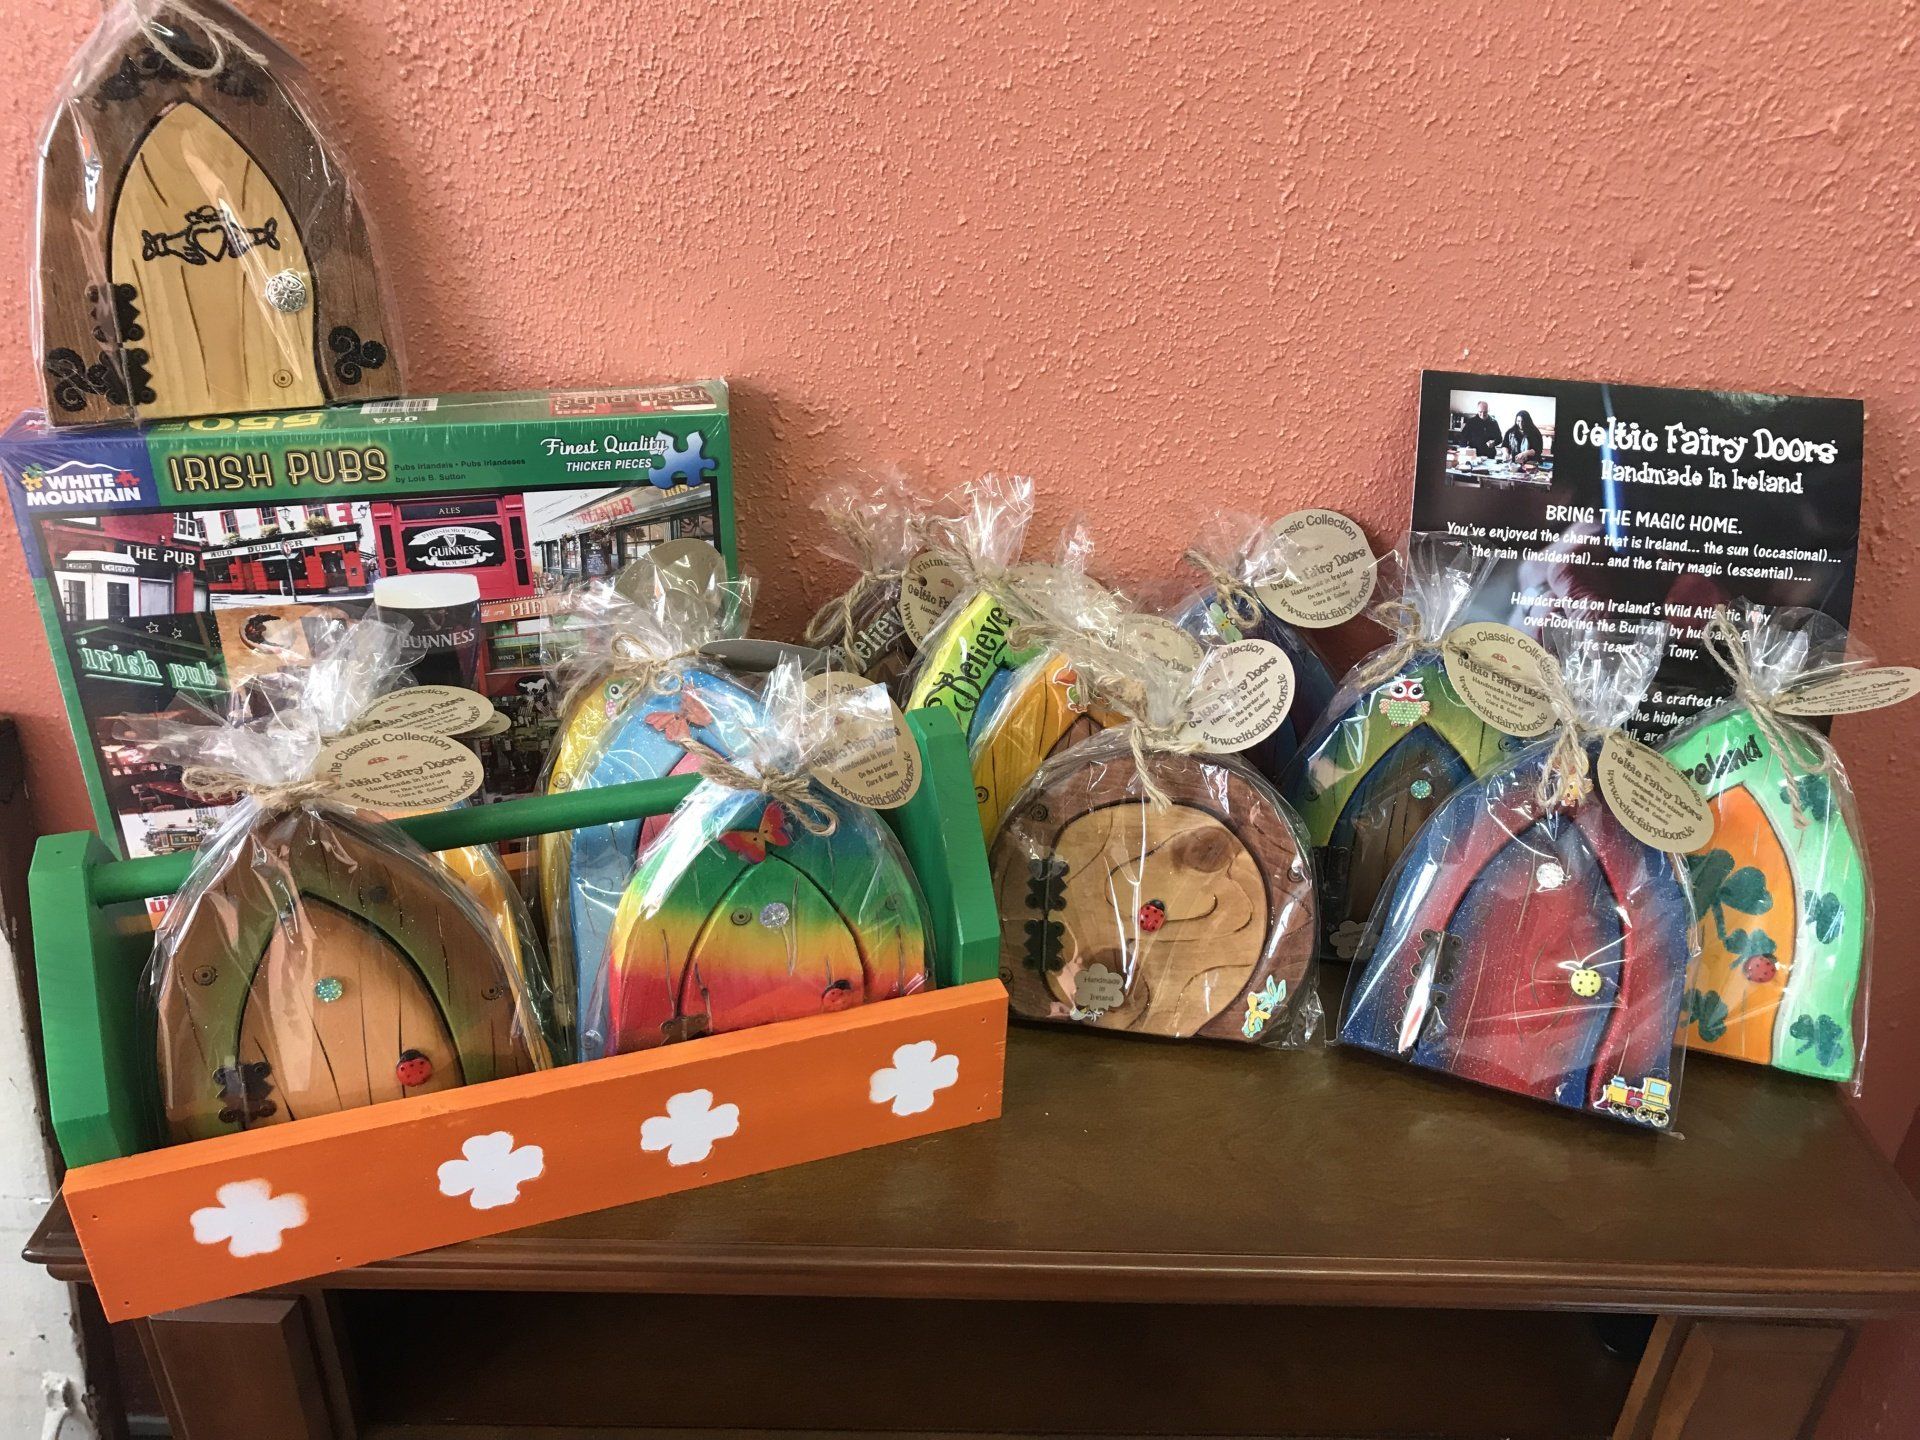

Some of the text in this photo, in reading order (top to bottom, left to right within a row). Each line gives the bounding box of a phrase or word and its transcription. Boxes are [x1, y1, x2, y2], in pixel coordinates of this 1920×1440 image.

[541, 434, 668, 456] Finest Quality
[1573, 416, 1839, 464] Celtic Fairy Doors
[169, 447, 388, 492] IRISH PUBS
[566, 458, 652, 472] THICKER PIECES
[1601, 458, 1804, 494] Handmade In Ireland
[45, 472, 116, 490] WHITE
[395, 476, 406, 484] by
[440, 473, 467, 481] Sutton
[26, 486, 142, 507] MOUNTAIN
[438, 507, 461, 515] ALES
[1545, 505, 1743, 535] BRING THE MAGIC HOME.
[1305, 514, 1358, 541] Collection
[428, 545, 482, 557] GUINNESS
[1447, 521, 1842, 563] You've enjoyed the charm that is Ireland... the sun (occasional)...
[126, 544, 196, 566] THE PUB
[1333, 547, 1367, 567] Doors
[1471, 544, 1812, 582] the rain (incidental)... and the fairy magic (essential)....
[1331, 567, 1354, 581] Ireland
[1511, 591, 1588, 610] Handcrafted
[1590, 601, 1605, 612] on
[1607, 598, 1661, 616] Ireland's
[1664, 603, 1692, 618] Wild
[1693, 605, 1741, 622] Atlatic
[1476, 630, 1516, 645] Classic
[1523, 612, 1594, 634] overlooking
[1597, 618, 1616, 633] the
[1669, 624, 1683, 640] by
[76, 637, 218, 689] irish pub
[924, 606, 1014, 713] Believe
[1668, 644, 1699, 660] Tony.
[1246, 656, 1278, 682] Doors
[1247, 676, 1269, 695] Ireland
[1651, 691, 1663, 704] &
[1666, 694, 1712, 708] crafted
[335, 731, 452, 761] Classic Collection
[381, 753, 467, 781] Fairy Doors
[1681, 734, 1763, 785] reland
[421, 769, 452, 780] Ireland
